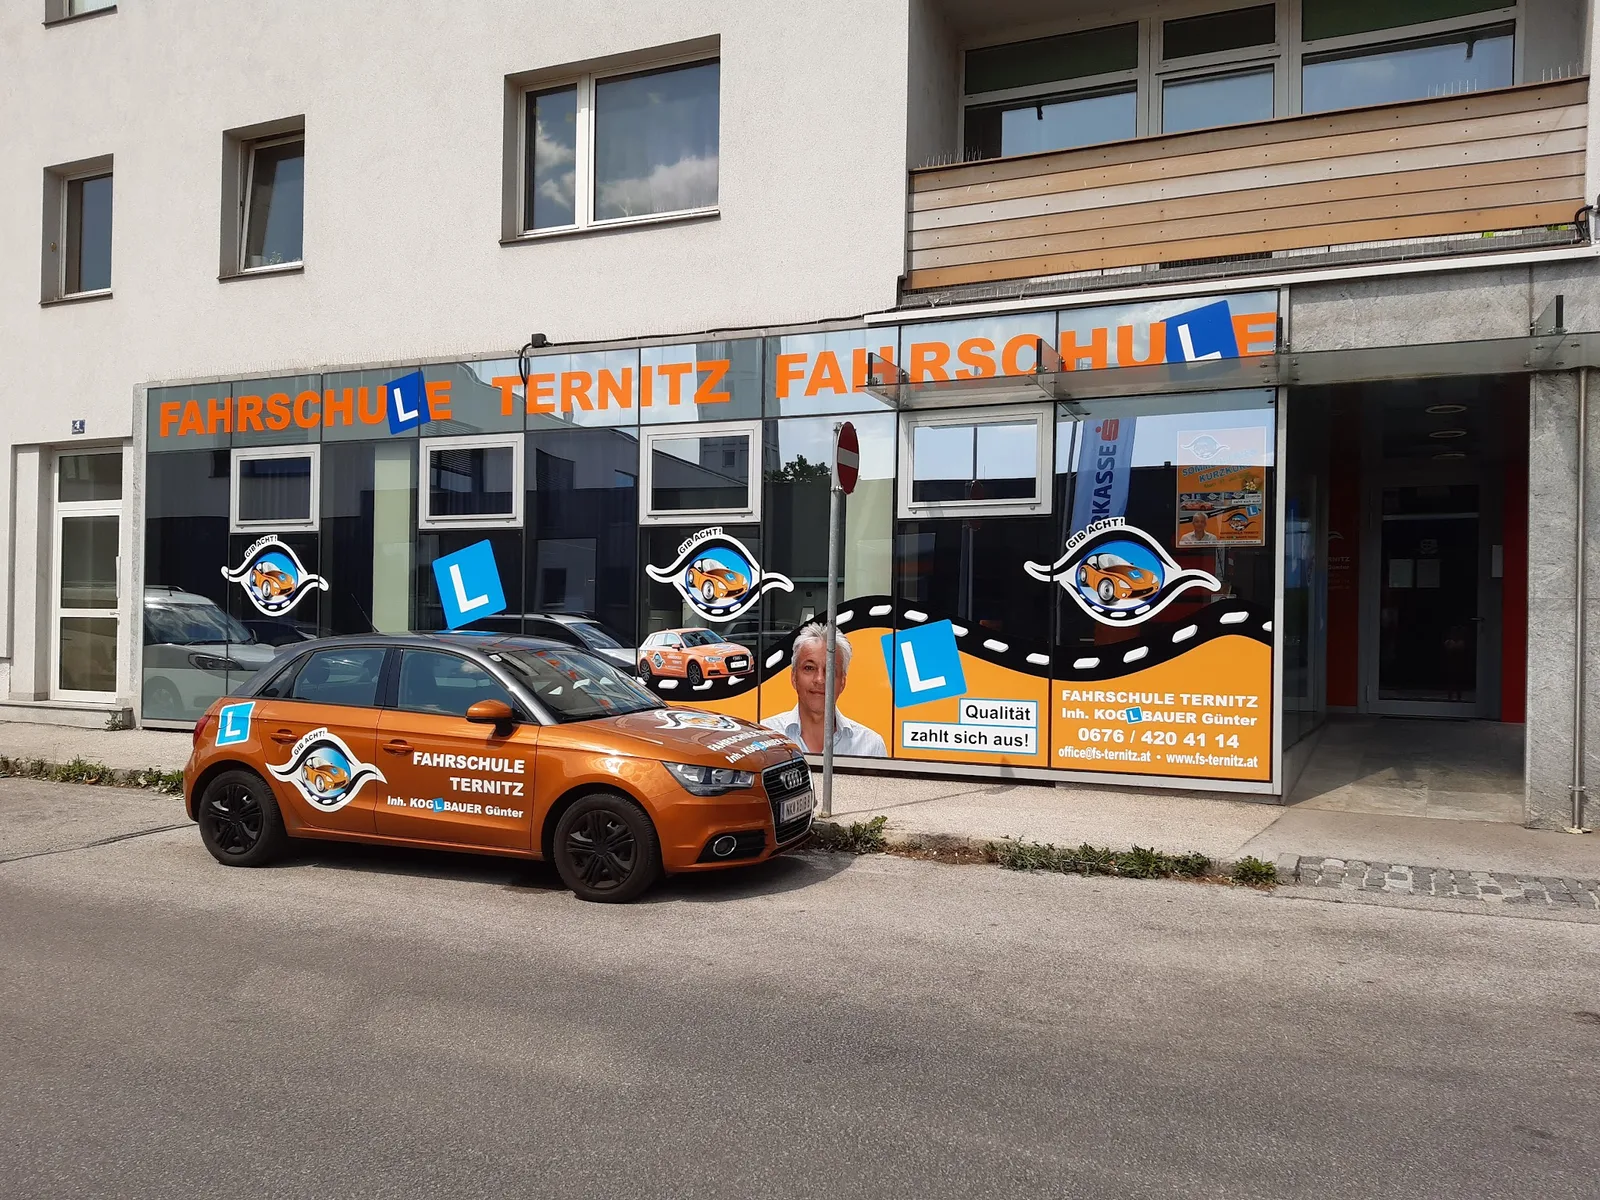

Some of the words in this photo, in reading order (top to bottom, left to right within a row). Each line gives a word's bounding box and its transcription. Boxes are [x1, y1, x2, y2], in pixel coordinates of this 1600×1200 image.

[775, 312, 1277, 398] FAHRSCHULE
[160, 380, 452, 437] FAHRSCHULE
[492, 359, 731, 416] TERNITZ
[256, 535, 278, 547] ACHT!
[679, 539, 694, 554] GIB
[694, 528, 722, 541] ACHT!
[1067, 531, 1087, 549] GIB
[1087, 517, 1124, 535] ACHT!
[450, 564, 489, 613] L
[900, 640, 947, 693] L
[1062, 689, 1175, 706] FAHRSCHULE
[1179, 693, 1258, 708] TERNITZ
[225, 711, 241, 737] L
[965, 704, 1031, 721] Qualität
[1062, 707, 1089, 721] Inh.
[1094, 707, 1197, 725] KOGLBAUER
[1201, 712, 1258, 727] Günter
[910, 728, 949, 743] zahlt
[953, 731, 988, 745] sich
[993, 732, 1029, 748] aus!
[1078, 727, 1125, 743] 0676
[1140, 729, 1178, 746] 420
[1183, 731, 1206, 747] 41
[1214, 732, 1240, 749] 14
[413, 751, 525, 774] FAHRSCHULE
[1058, 746, 1151, 762] office@fs-ternitz.at
[1166, 752, 1258, 768] www.fs-ternitz.at
[449, 776, 524, 797] TERNITZ
[387, 795, 407, 807] Inh.
[485, 806, 524, 819] Günter
